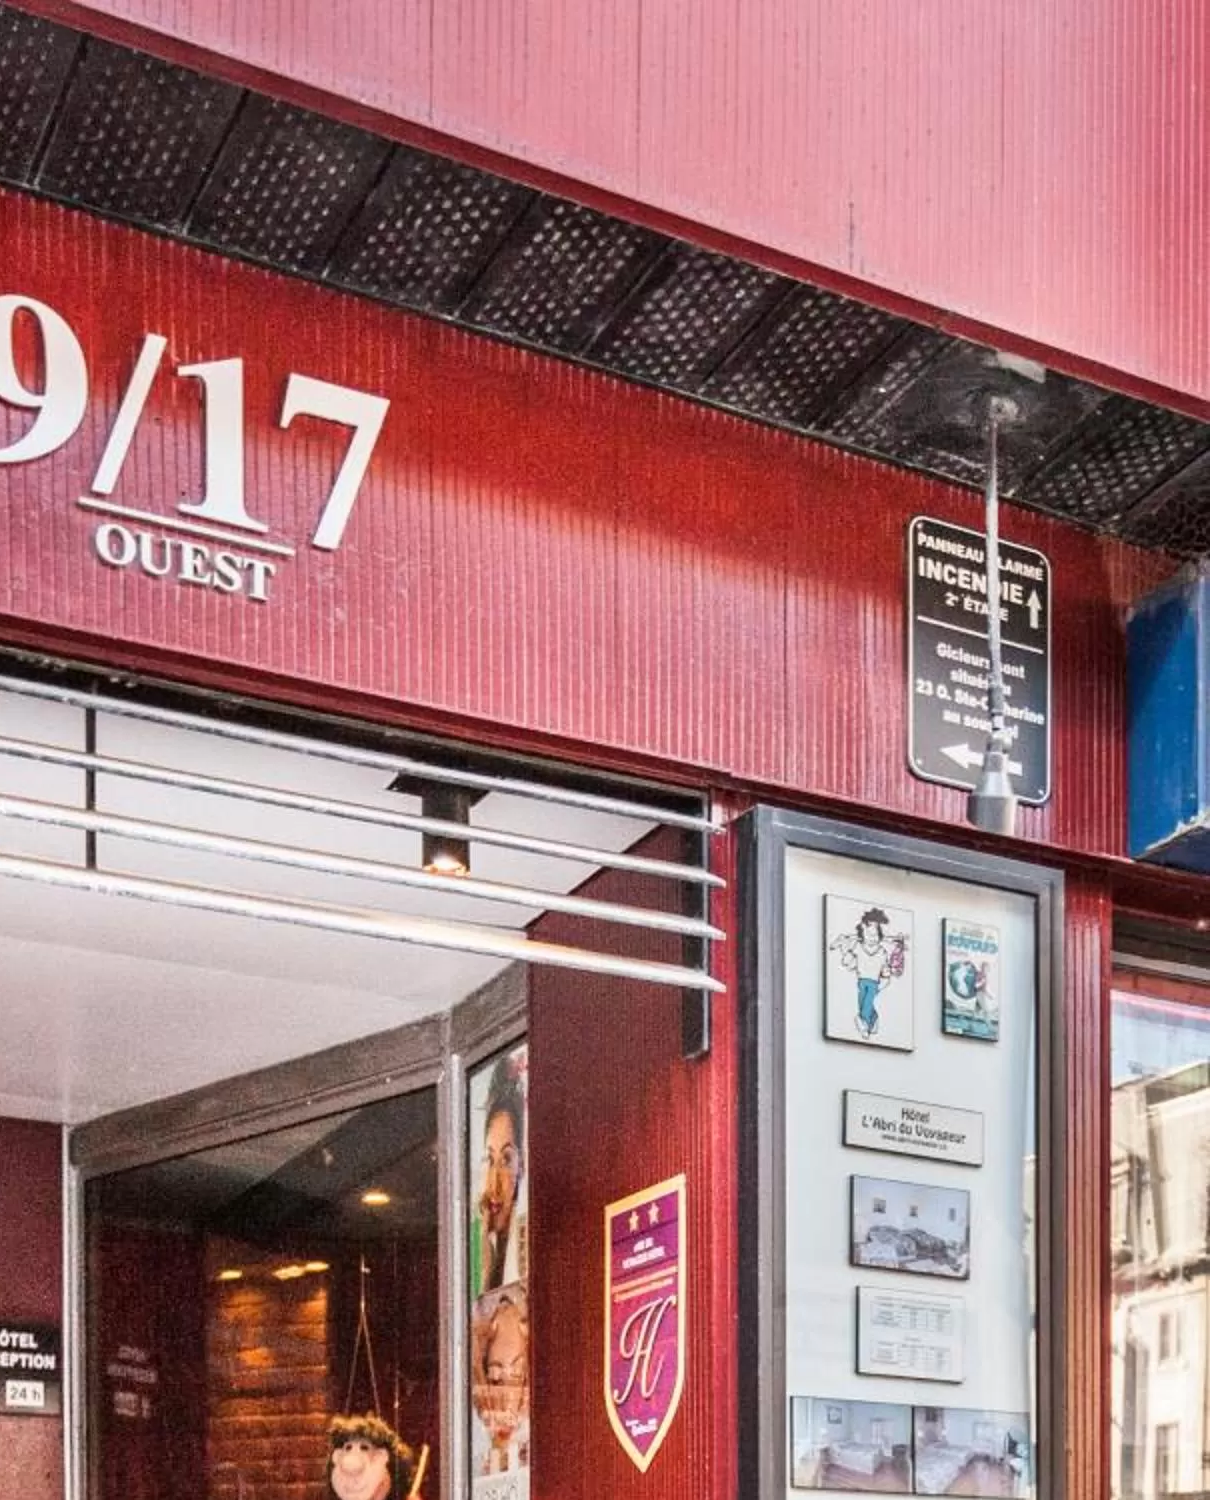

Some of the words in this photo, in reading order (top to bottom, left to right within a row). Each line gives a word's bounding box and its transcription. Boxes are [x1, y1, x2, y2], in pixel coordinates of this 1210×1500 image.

[95, 523, 276, 601] OUEST
[917, 531, 985, 563] PANNEAU
[989, 555, 1044, 581] LARME
[918, 556, 1024, 605] INCENIE
[963, 594, 1009, 621] ÉTAE
[916, 678, 934, 697] 23
[954, 688, 1045, 726] Ste-Cherine
[9, 1385, 28, 1401] 24
[32, 1388, 41, 1401] h
